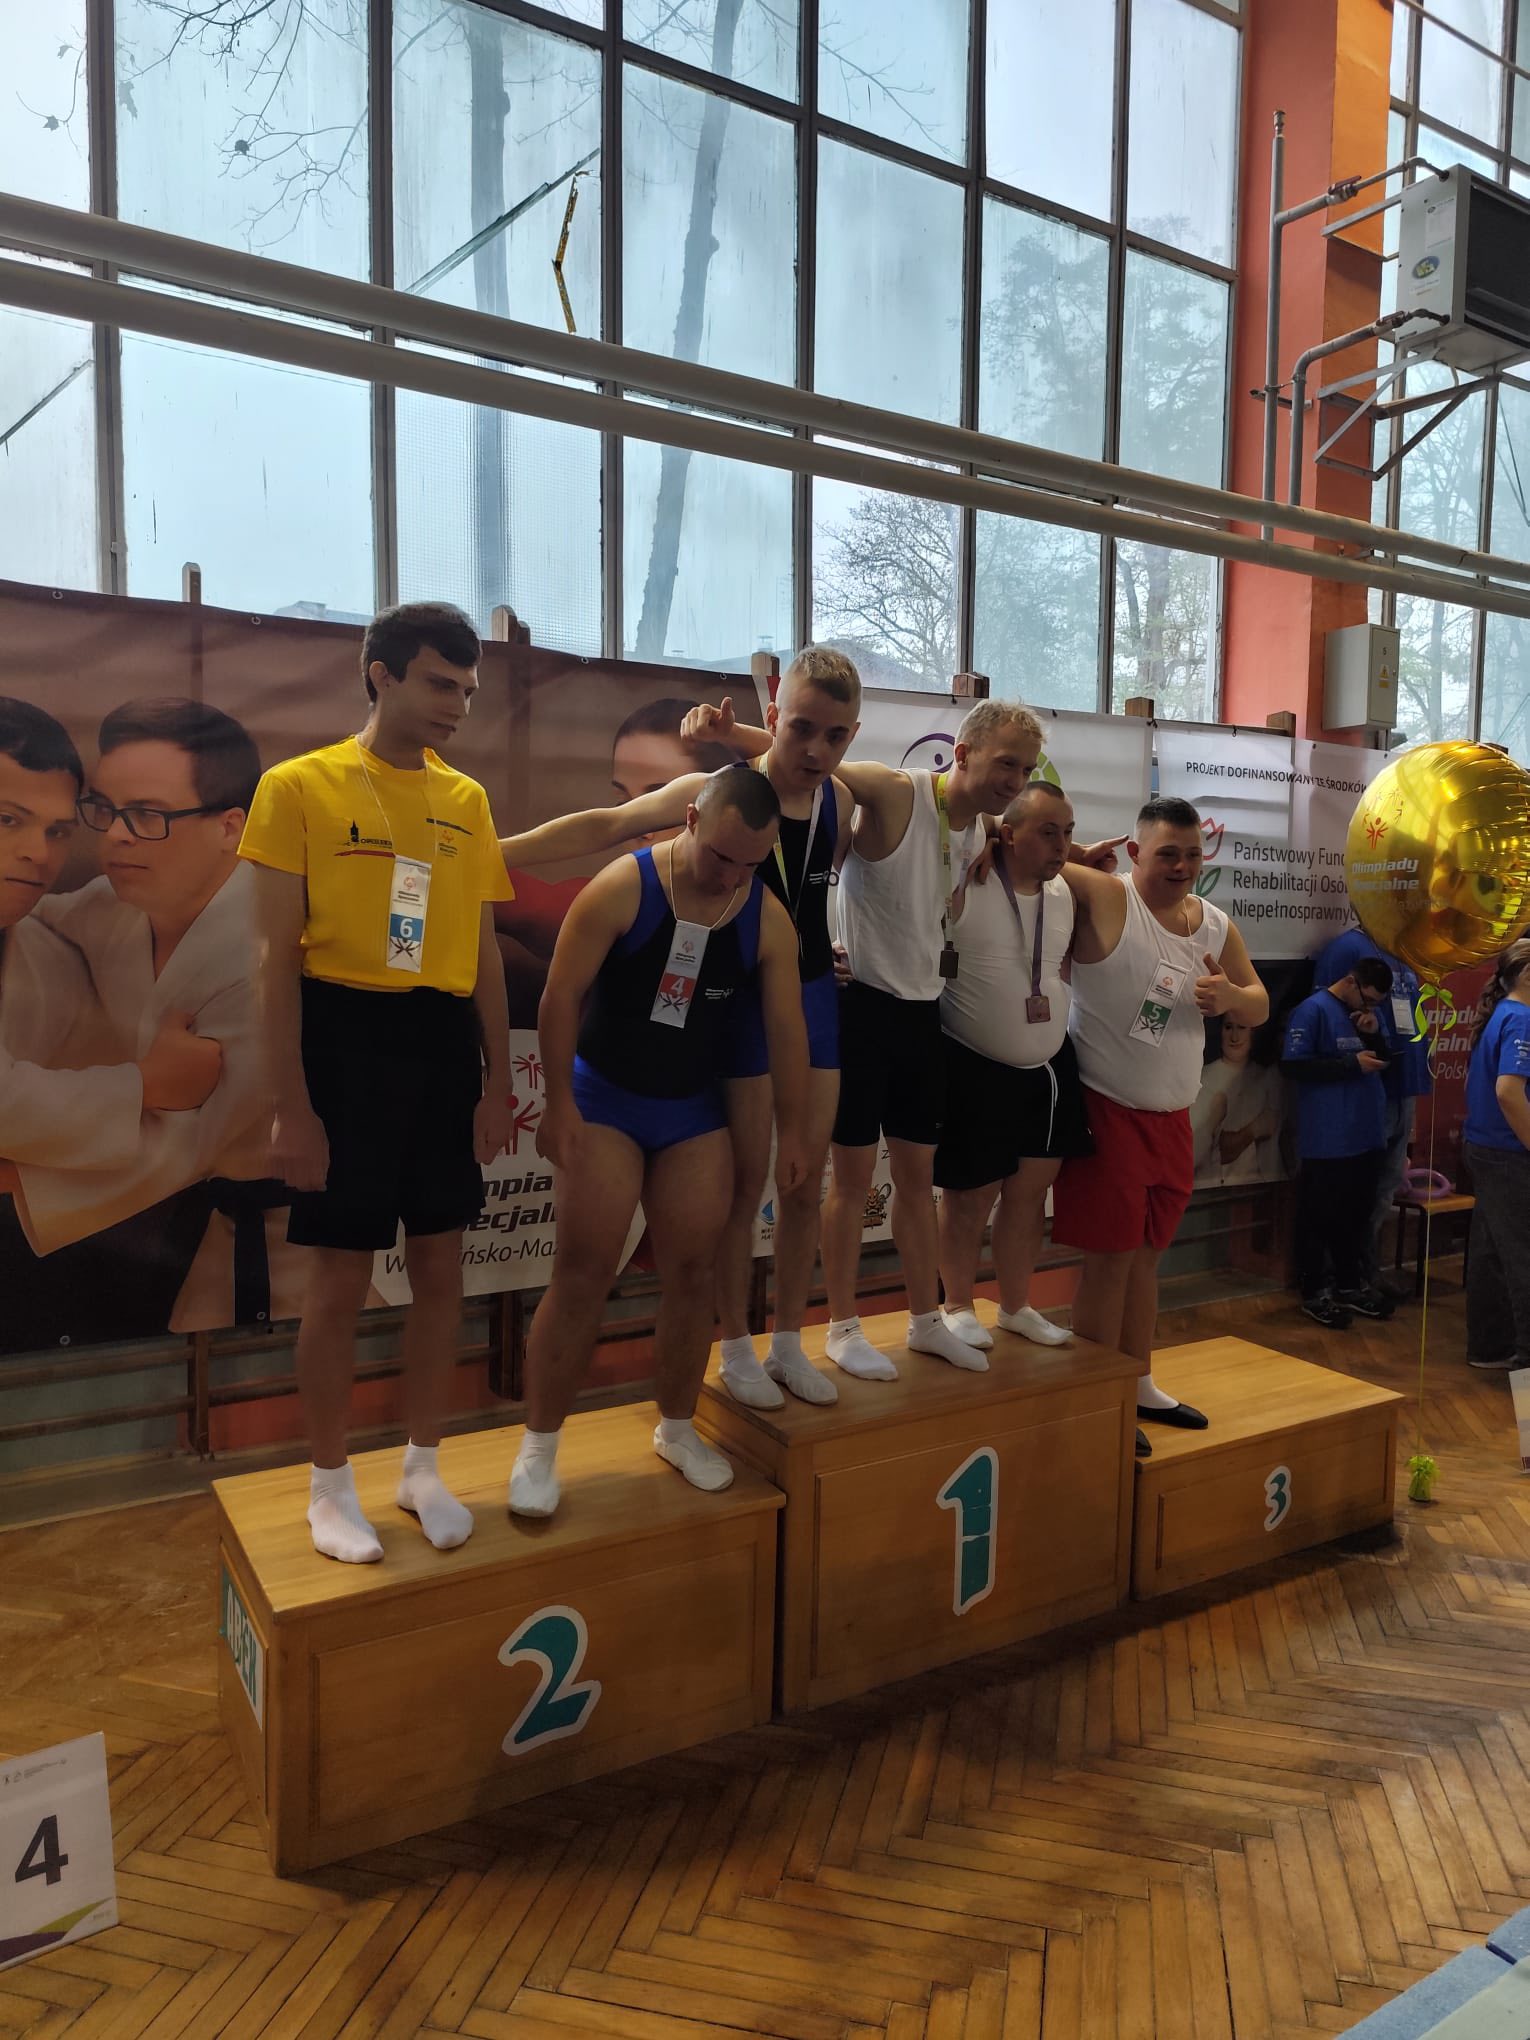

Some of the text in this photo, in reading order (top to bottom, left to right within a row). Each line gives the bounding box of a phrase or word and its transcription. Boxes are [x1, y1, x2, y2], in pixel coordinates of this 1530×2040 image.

[1186, 761, 1226, 777] PROJEKT
[1234, 841, 1315, 869] Państwowy
[1352, 857, 1419, 873] Olimpiady
[1233, 870, 1317, 897] Rehabilitacji
[1232, 899, 1356, 926] Niepełnosprawnyc
[400, 918, 413, 938] 6
[671, 976, 684, 994] 4
[1149, 1004, 1163, 1020] 5
[465, 1202, 557, 1234] ecjal
[1264, 1466, 1292, 1532] 3
[936, 1446, 1000, 1617] 1
[498, 1605, 602, 1757] 2
[14, 1814, 69, 1887] 4
